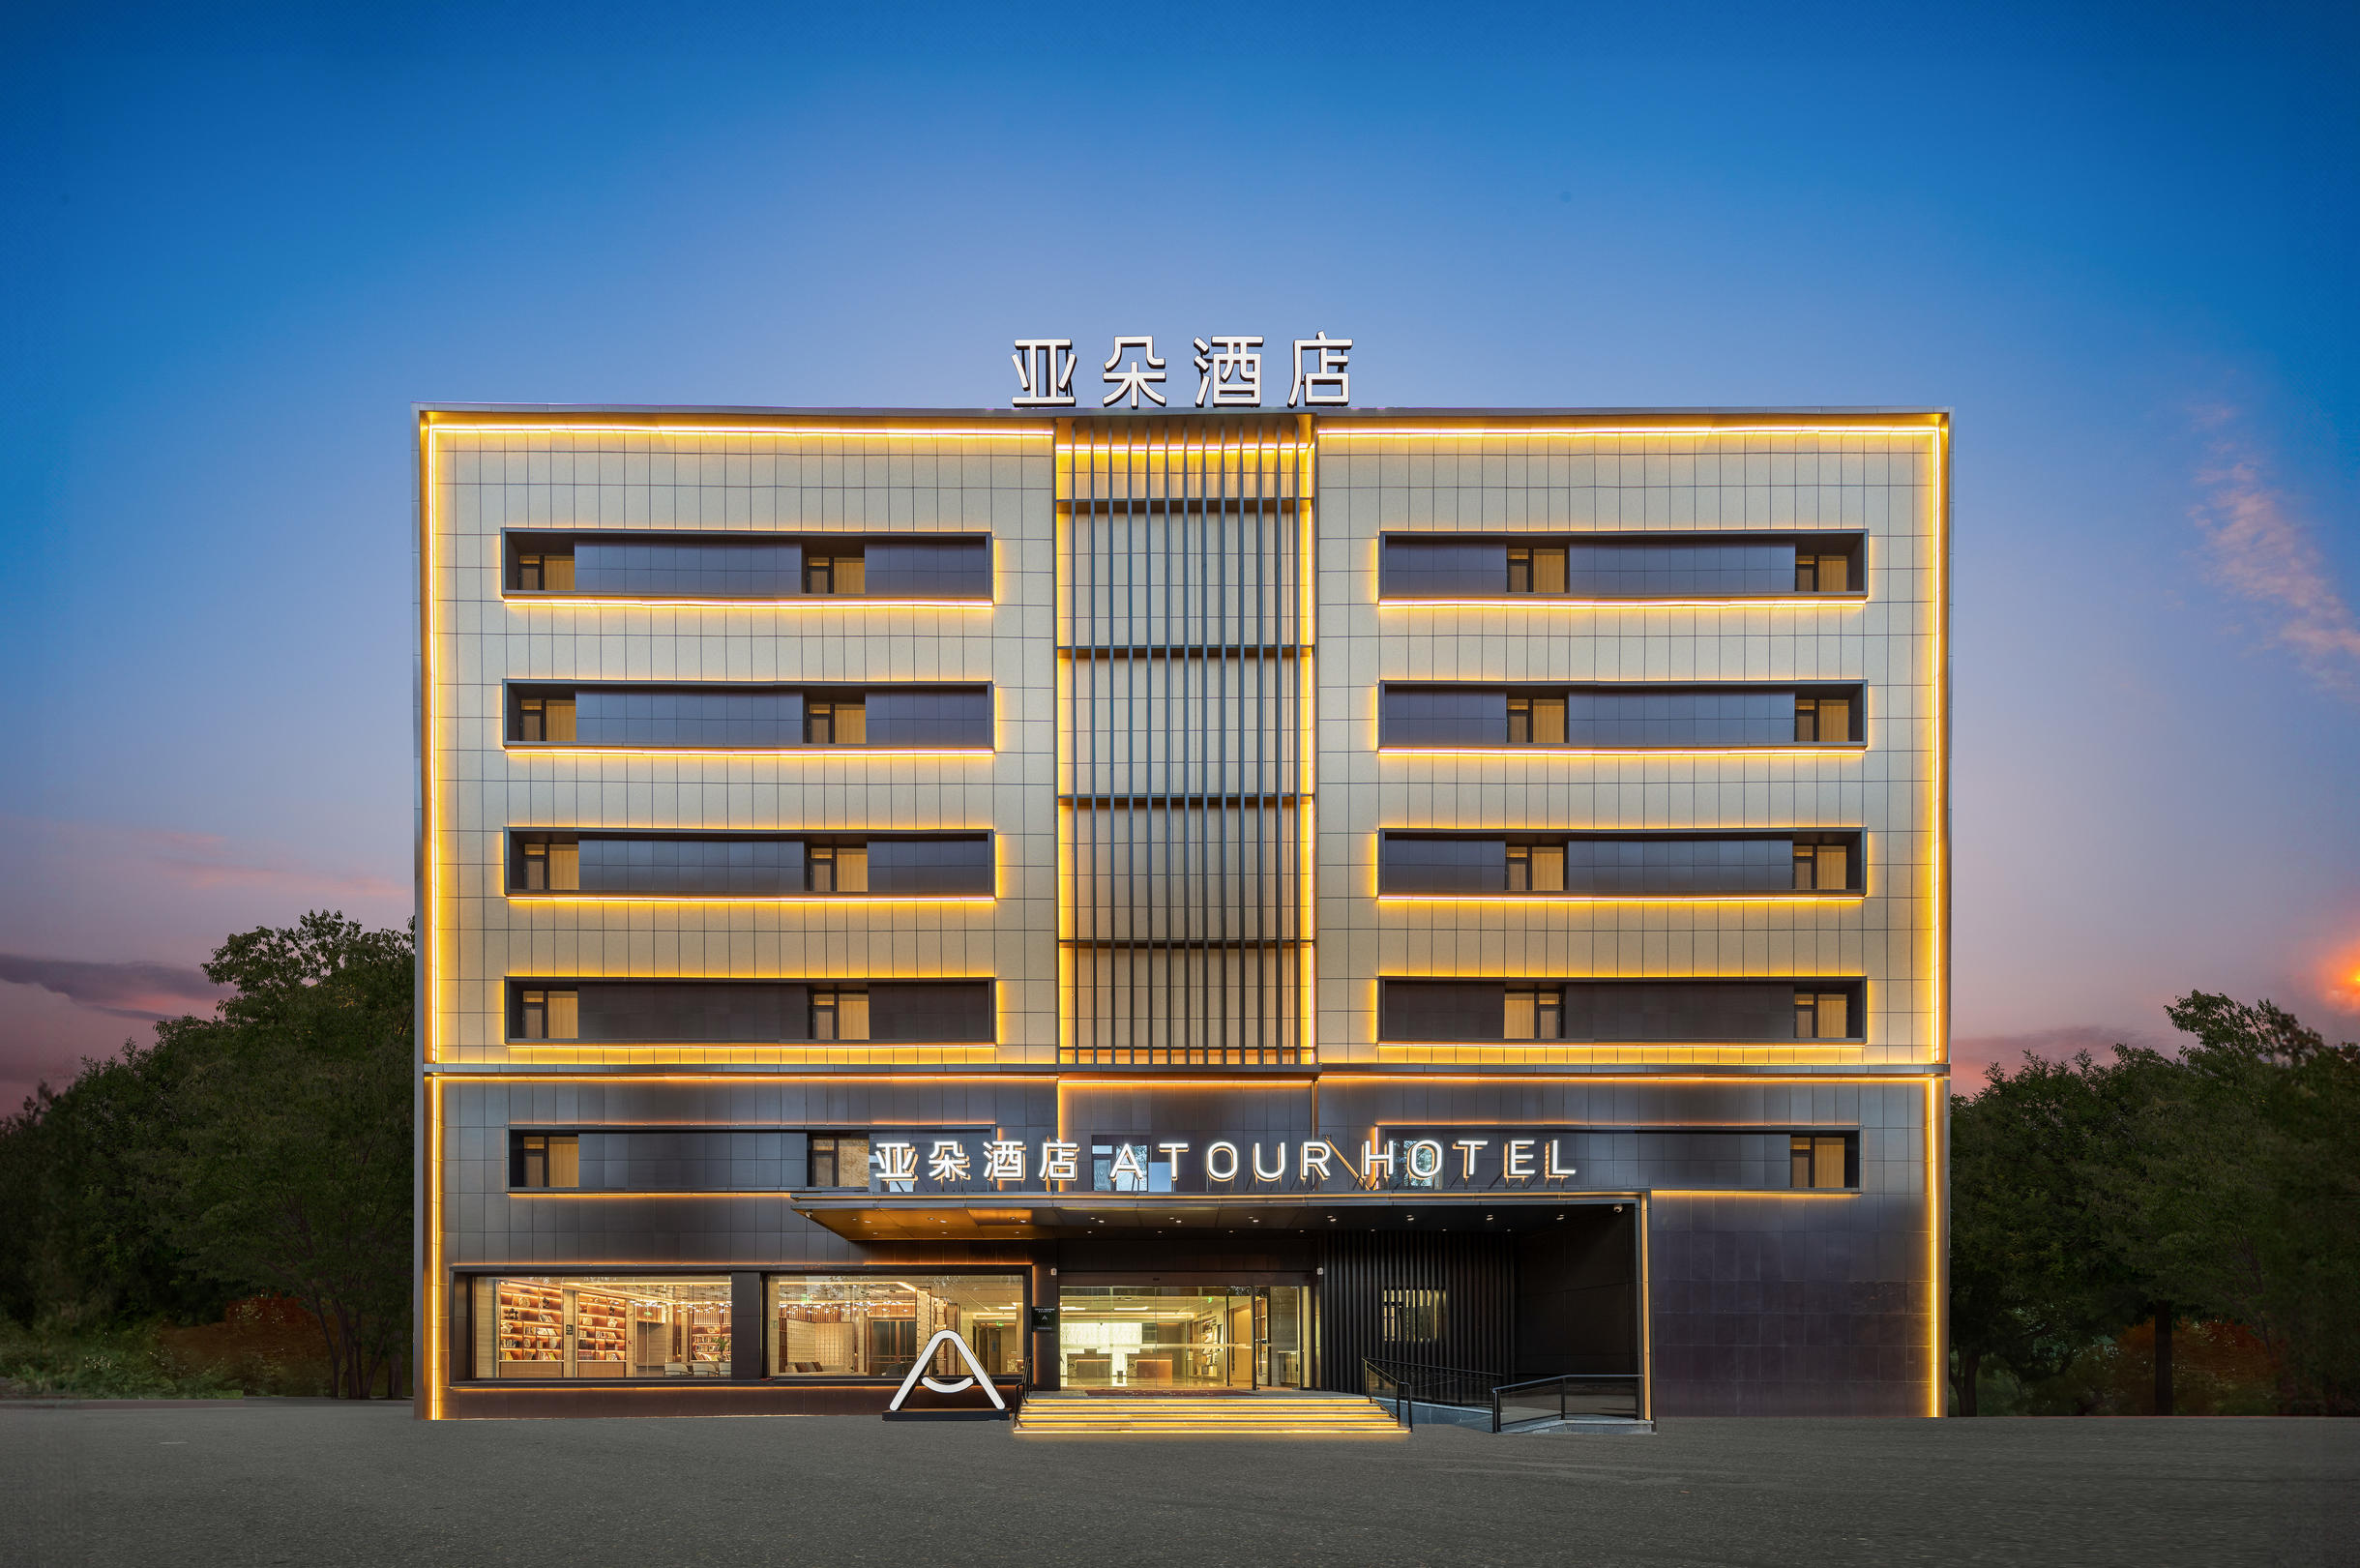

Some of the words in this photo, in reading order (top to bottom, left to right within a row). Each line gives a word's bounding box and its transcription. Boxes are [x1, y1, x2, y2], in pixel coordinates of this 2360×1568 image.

[1012, 331, 1353, 408] 亚朵酒店
[874, 1139, 1079, 1180] 亚朵酒店
[1109, 1141, 1332, 1180] ATOUR
[1362, 1139, 1577, 1178] HOTEL
